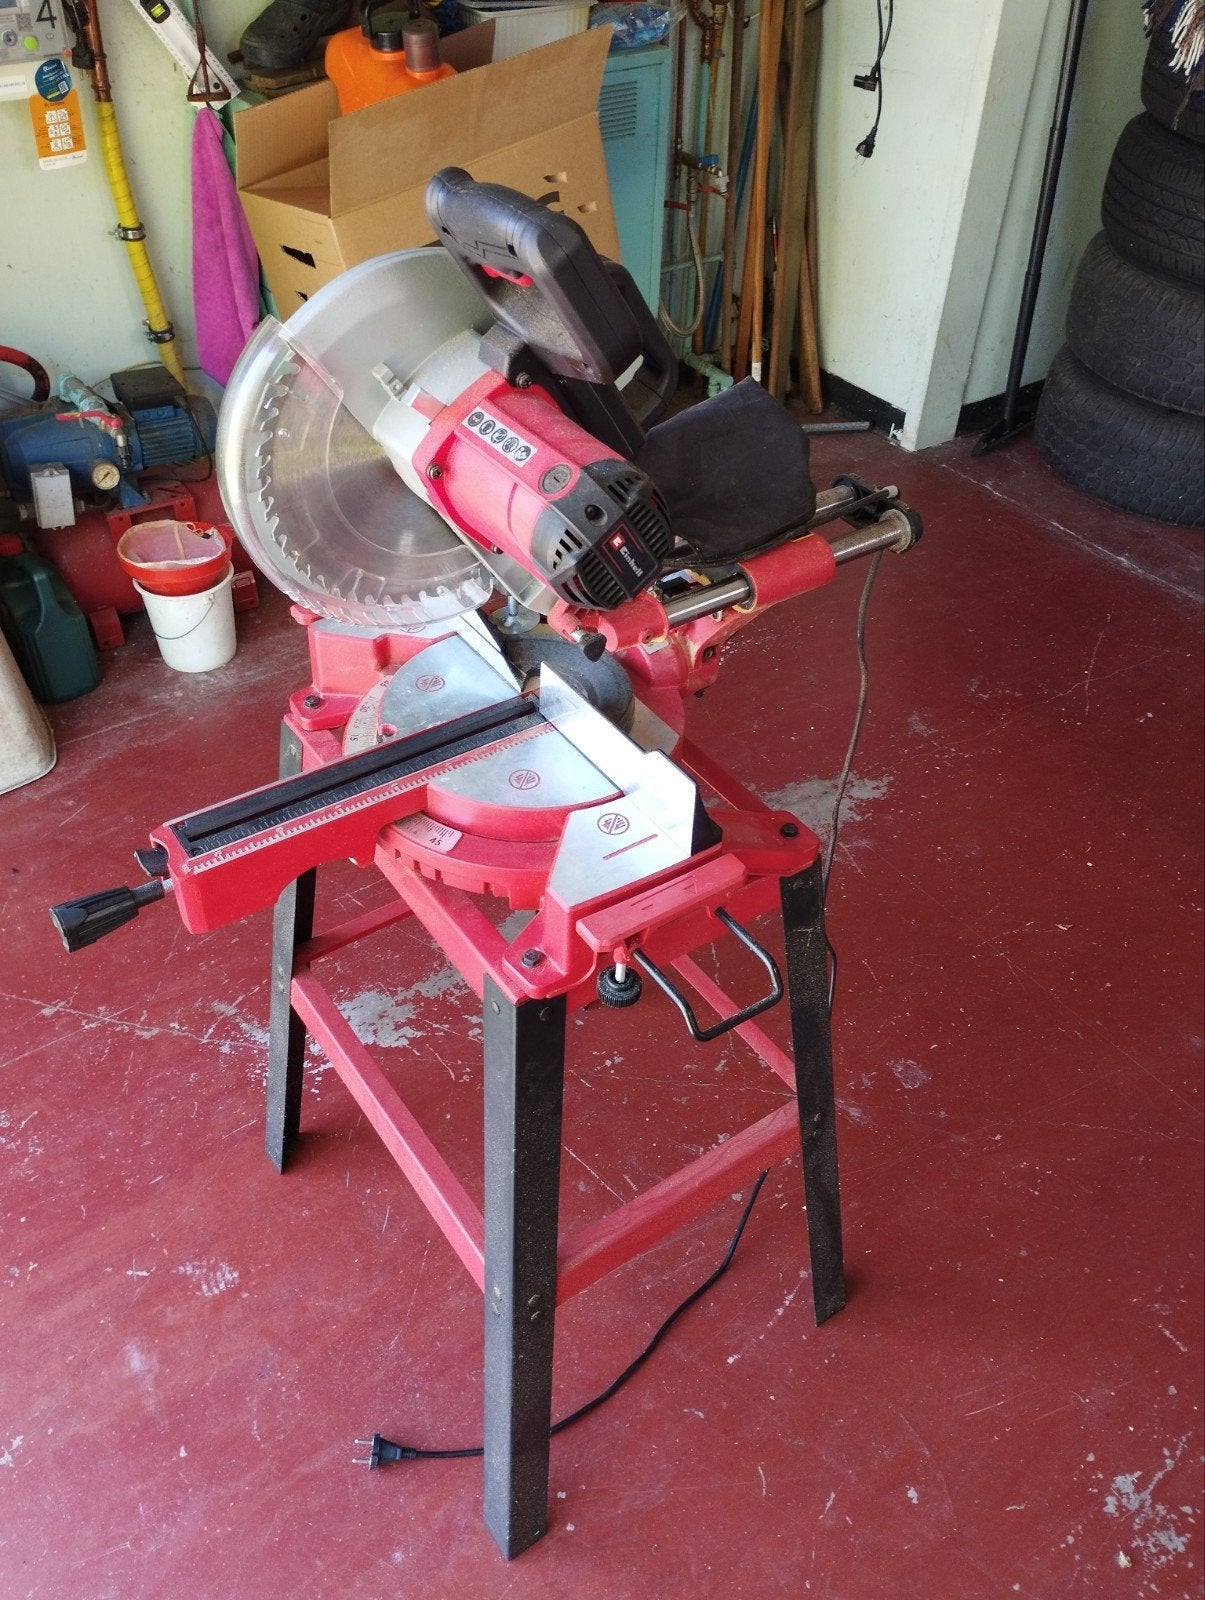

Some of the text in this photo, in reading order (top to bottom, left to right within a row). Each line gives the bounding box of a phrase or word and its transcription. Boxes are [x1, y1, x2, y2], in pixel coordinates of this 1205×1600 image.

[36, 0, 58, 29] 4
[619, 545, 644, 578] Einhell
[429, 837, 443, 846] 45
